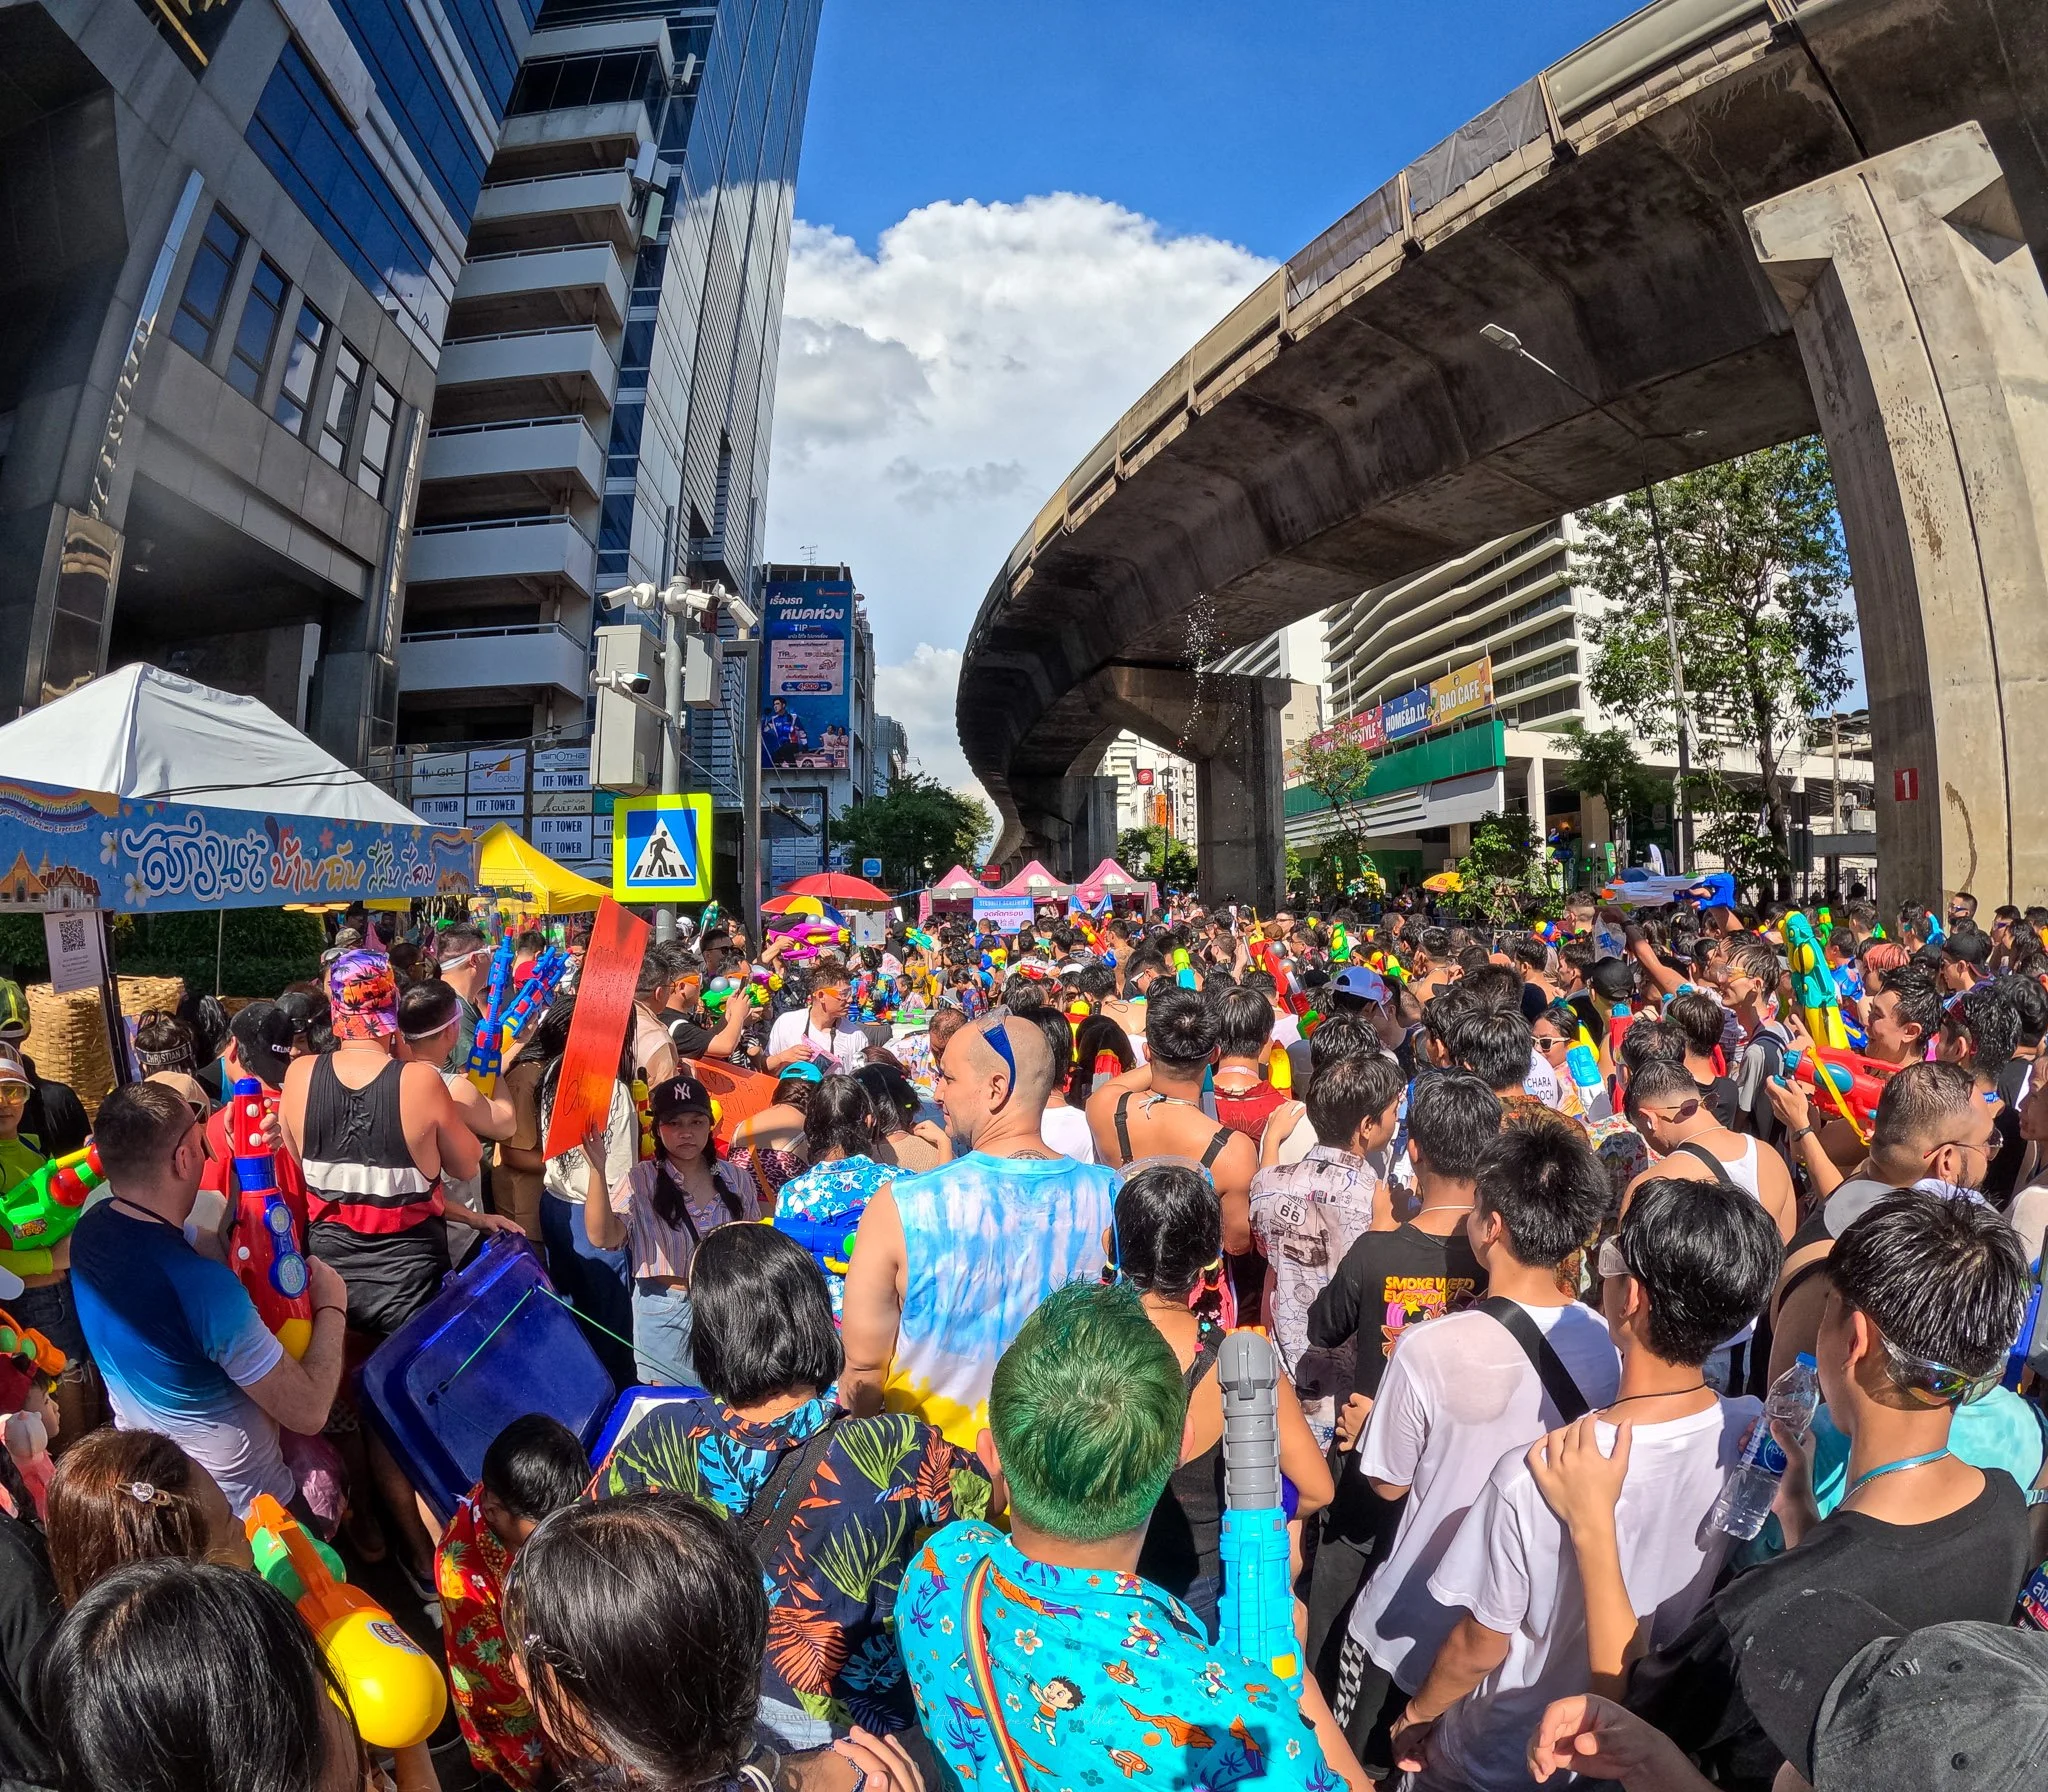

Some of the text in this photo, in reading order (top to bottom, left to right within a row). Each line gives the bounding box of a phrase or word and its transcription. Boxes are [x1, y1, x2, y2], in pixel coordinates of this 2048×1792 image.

[770, 592, 803, 605] เรื่องรถ
[780, 604, 844, 620] หมดห่วง
[793, 624, 808, 632] TIP
[1439, 679, 1481, 713] BAO CAFE
[437, 767, 456, 777] GIT
[494, 773, 521, 783] Today
[542, 774, 584, 787] ITF TOWER
[1902, 771, 1911, 799] 1
[421, 800, 459, 813] ITF TOWER
[475, 799, 516, 811] ITF TOWER
[541, 820, 583, 833] ITF TOWER
[541, 841, 582, 854] ITF TOWER
[674, 1082, 691, 1100] NY
[1280, 1204, 1300, 1223] 66
[1385, 1275, 1476, 1291] SMOKE WEED
